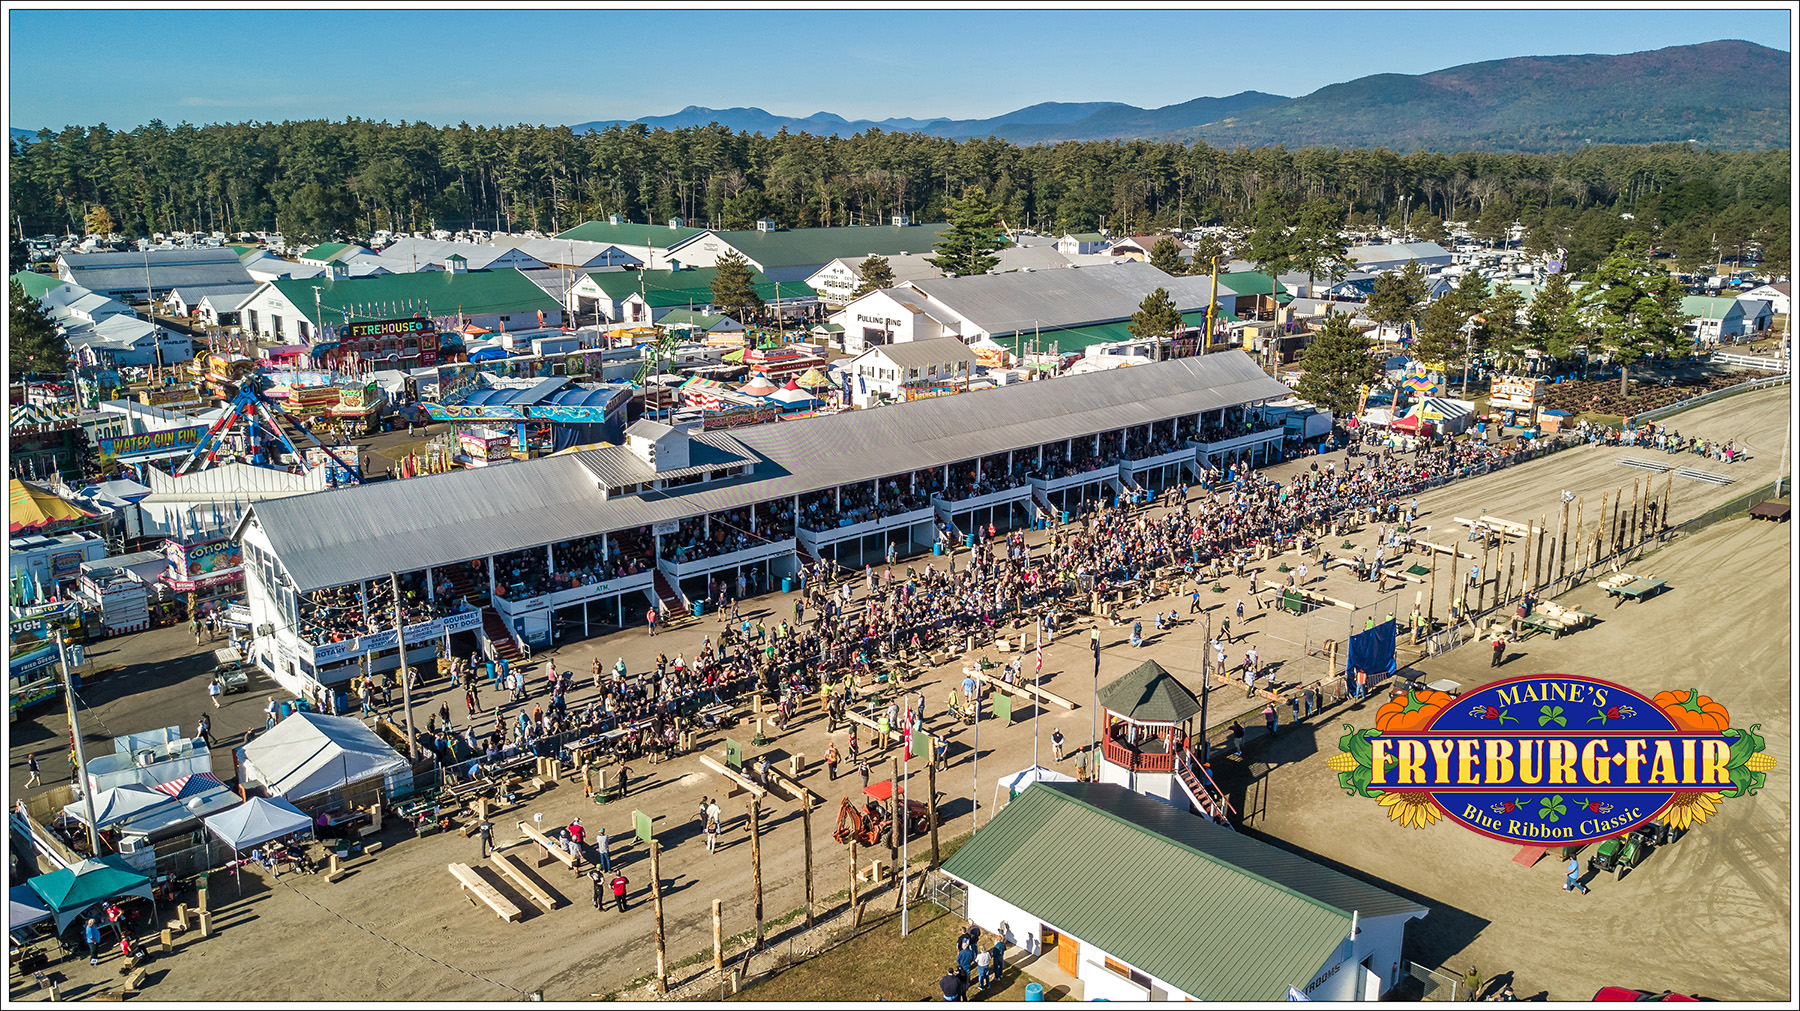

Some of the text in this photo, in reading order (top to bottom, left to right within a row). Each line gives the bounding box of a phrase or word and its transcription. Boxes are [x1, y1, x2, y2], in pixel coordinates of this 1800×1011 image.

[857, 314, 902, 327] PULLING RING
[352, 321, 416, 337] FIREHOUSE
[1492, 384, 1533, 397] FRIES
[11, 418, 78, 437] MAKE IT RAIN
[113, 428, 198, 454] WATER GUN FUN
[488, 439, 508, 448] FRIED
[487, 450, 511, 460] OREOS
[189, 541, 230, 560] COTTON
[443, 611, 479, 625] GOURMET
[460, 617, 480, 627] DOGS
[315, 646, 347, 659] ROTARY
[21, 654, 56, 671] FRIED OREOS
